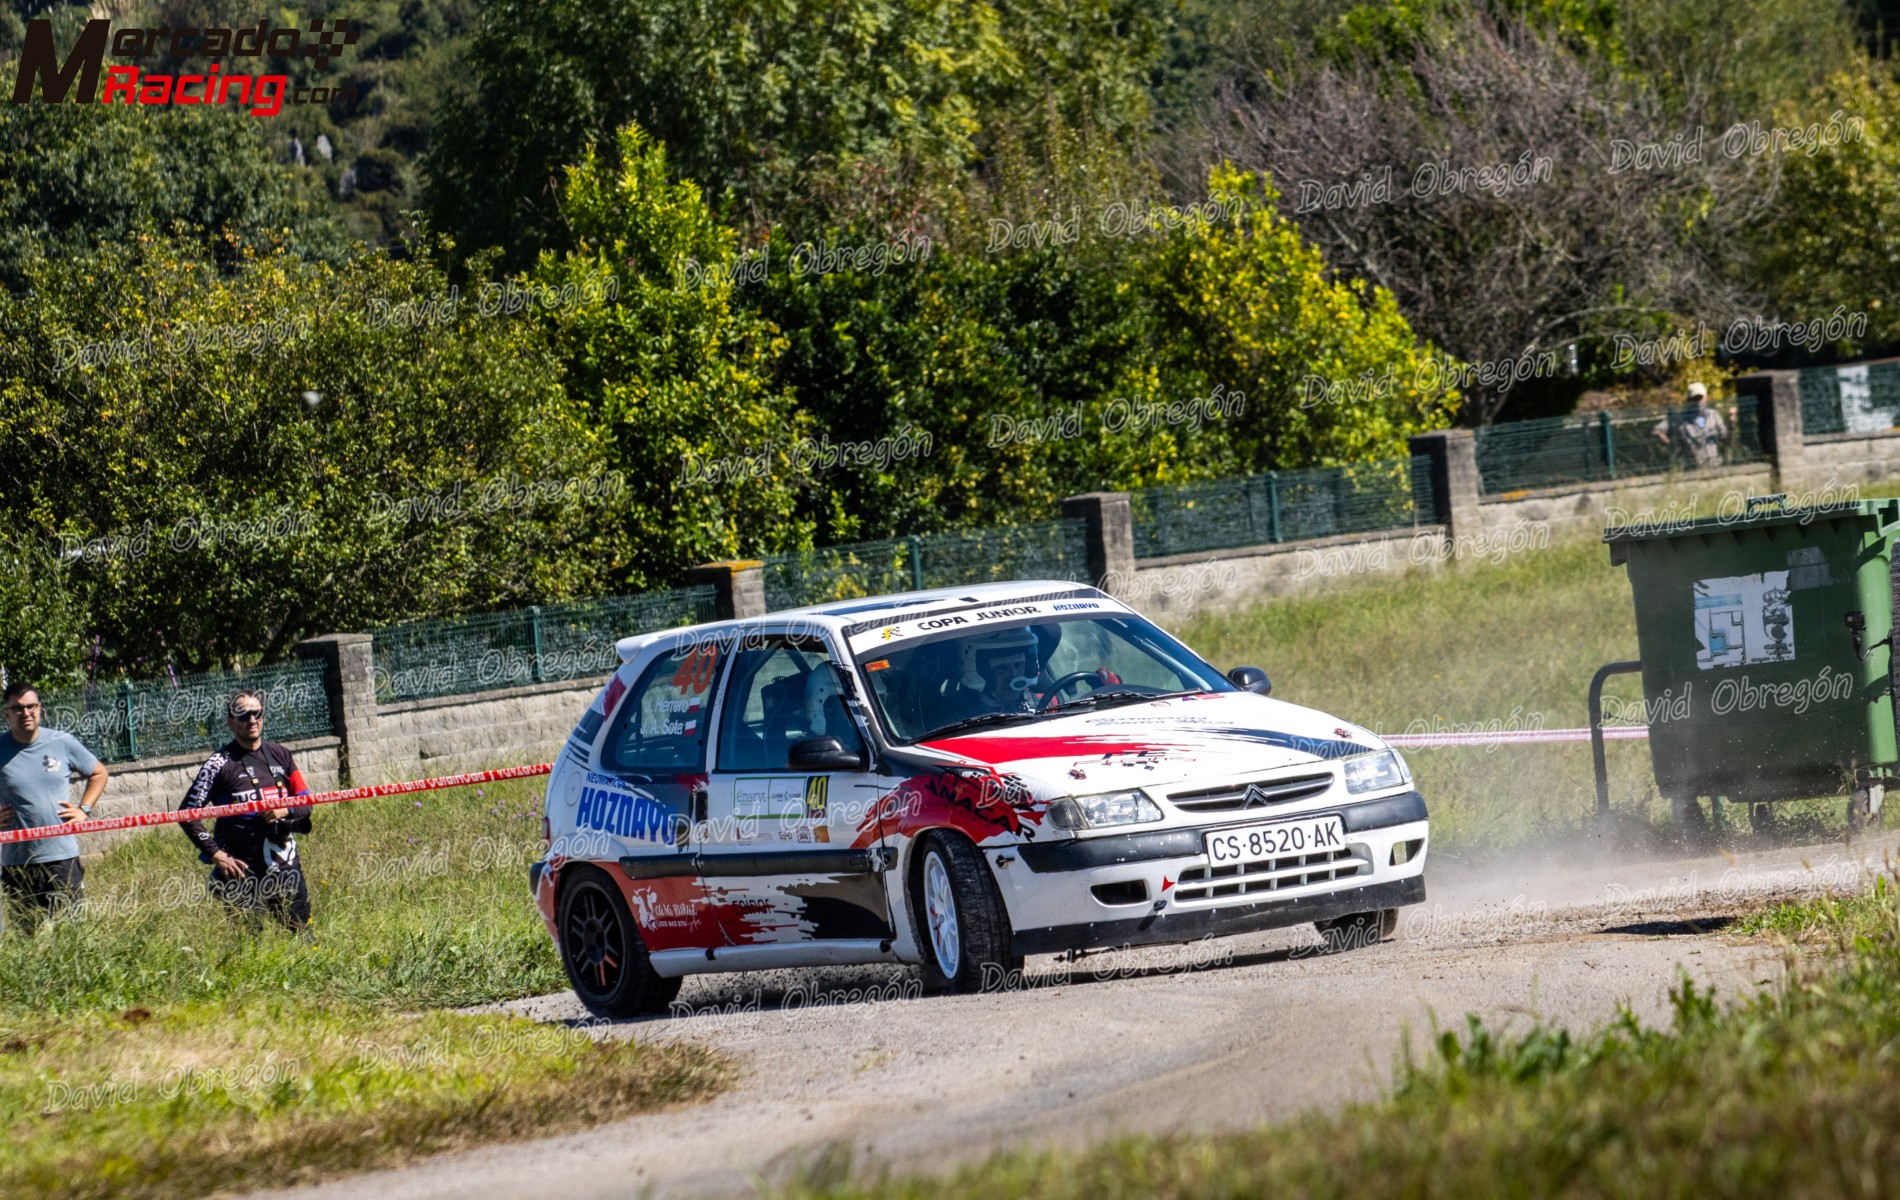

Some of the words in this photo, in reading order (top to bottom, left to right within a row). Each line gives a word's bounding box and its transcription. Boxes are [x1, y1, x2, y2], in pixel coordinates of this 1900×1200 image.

[917, 616, 968, 631] COPA
[976, 606, 1042, 621] JUNIOR
[672, 644, 719, 695] 40
[654, 696, 689, 713] Herrero
[662, 718, 684, 735] Sota
[807, 776, 827, 811] 40
